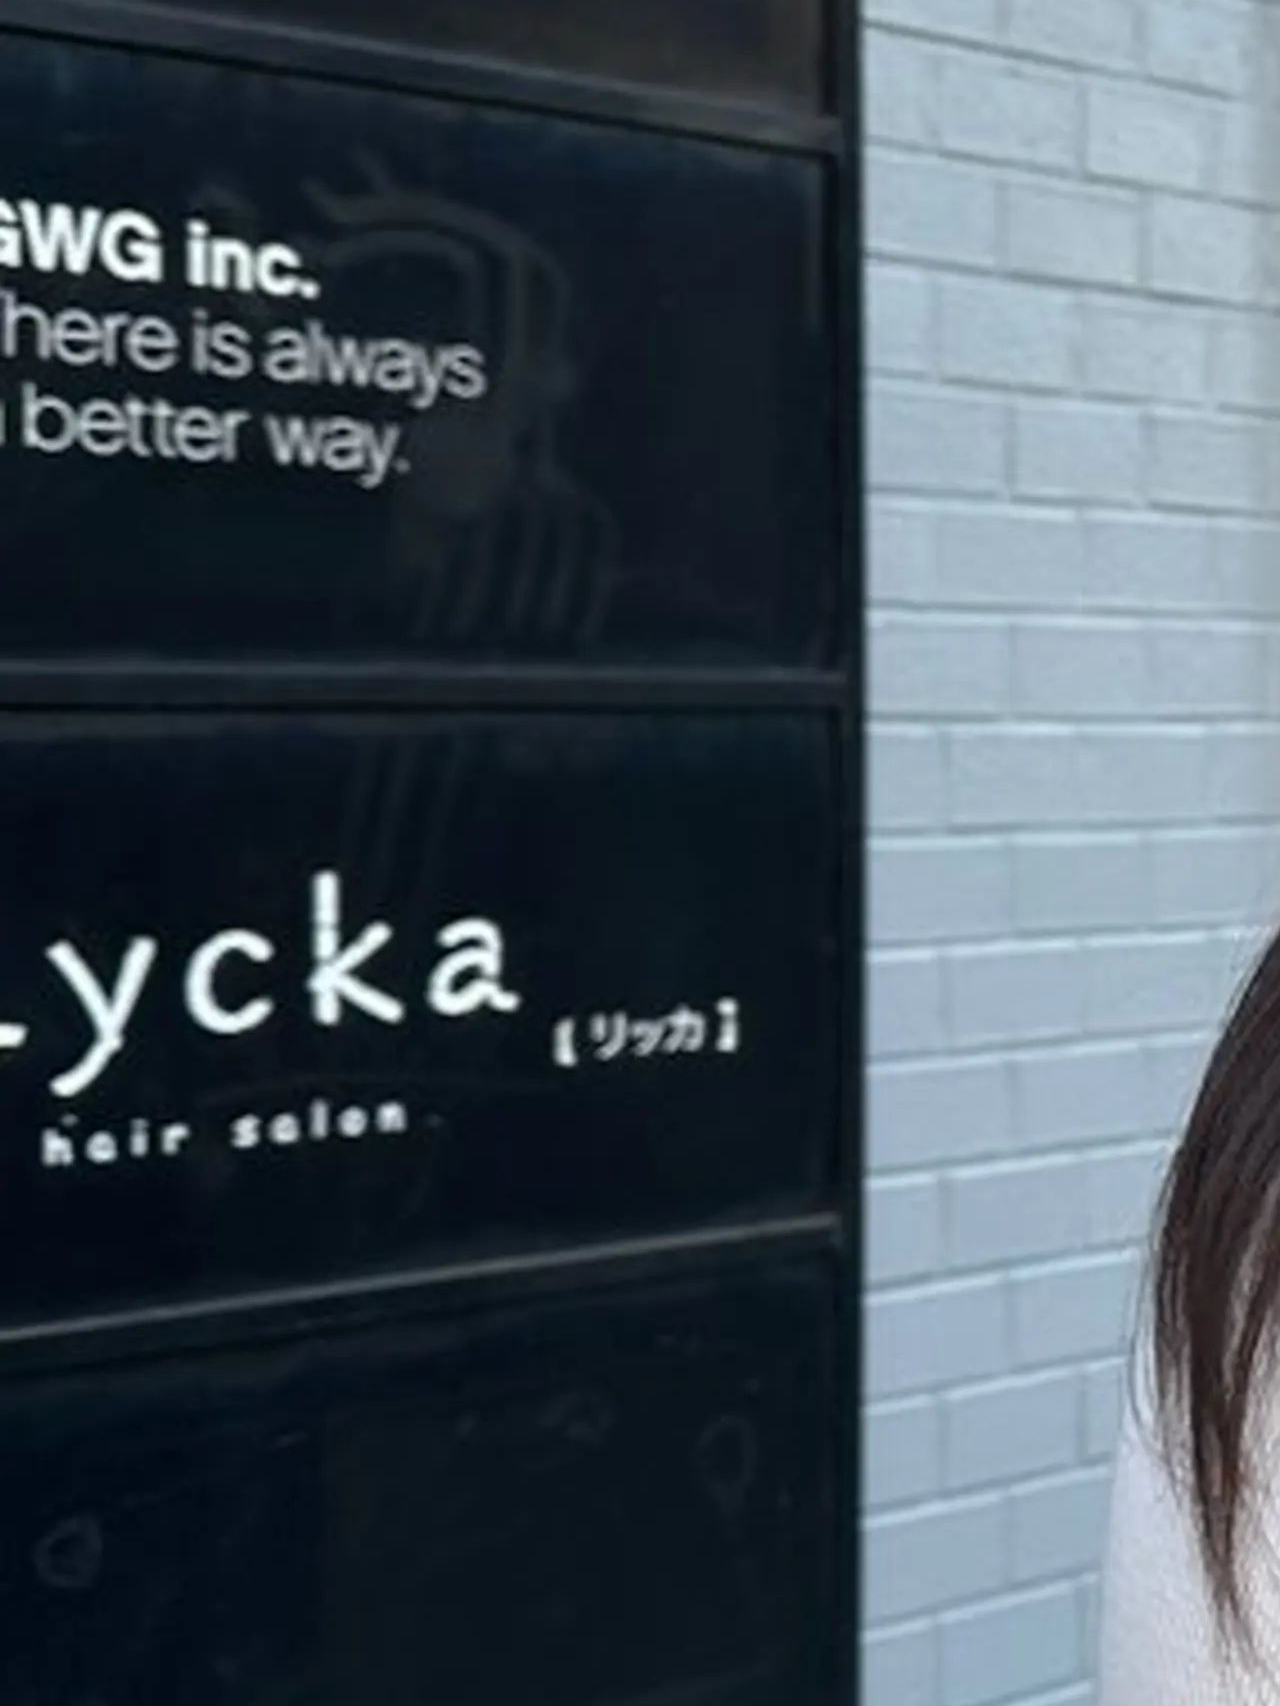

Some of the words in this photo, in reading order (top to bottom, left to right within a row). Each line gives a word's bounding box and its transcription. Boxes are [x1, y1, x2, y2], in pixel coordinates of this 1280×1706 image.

[185, 218, 322, 301] inc.
[0, 286, 181, 373] here
[192, 307, 253, 379] is
[262, 319, 488, 411] always
[20, 381, 251, 463] better
[264, 412, 412, 490] way.
[0, 870, 522, 1098] ycka
[40, 1117, 191, 1168] hair
[229, 1098, 409, 1150] salon
